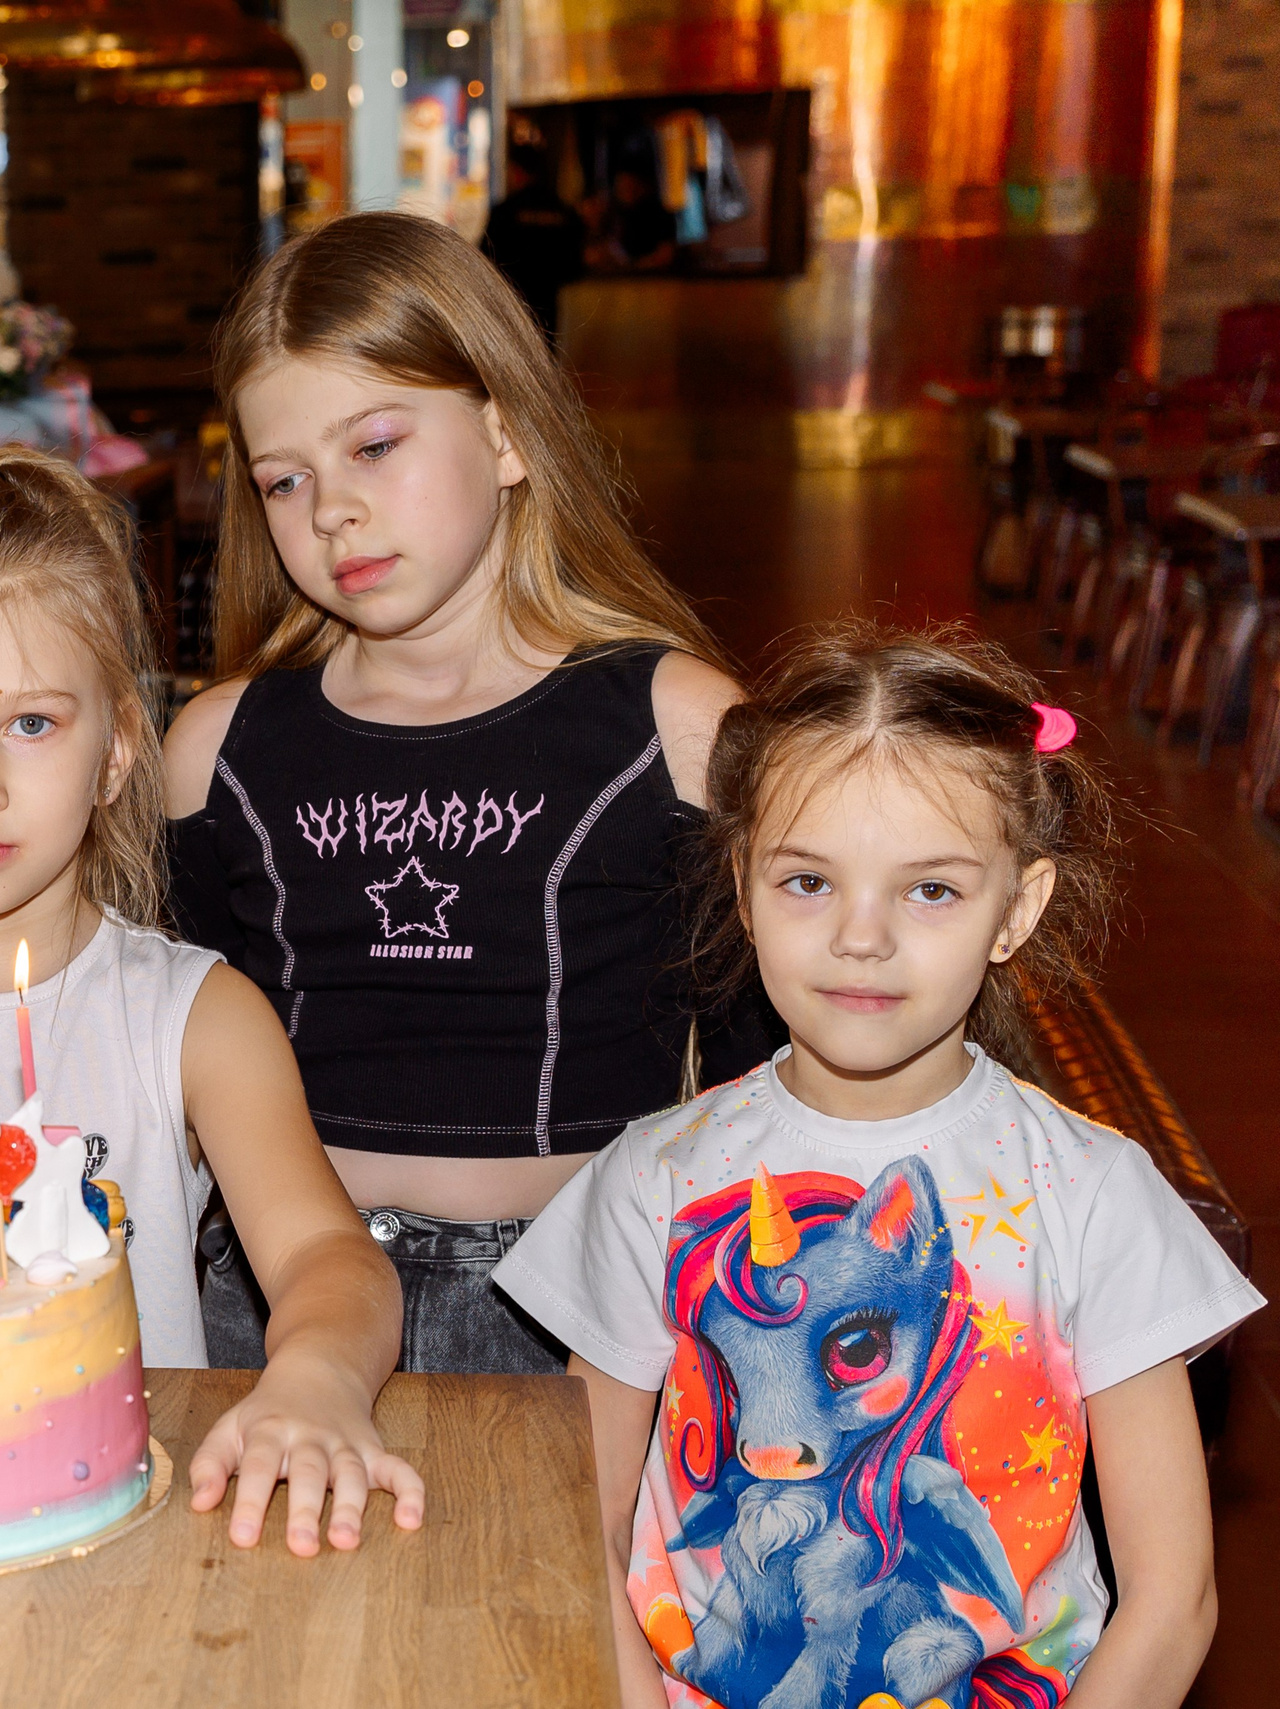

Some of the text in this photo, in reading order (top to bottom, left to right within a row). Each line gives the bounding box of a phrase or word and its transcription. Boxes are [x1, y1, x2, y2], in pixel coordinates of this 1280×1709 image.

[296, 788, 545, 859] WIZARDY
[369, 944, 474, 960] ILLUSION STAR
